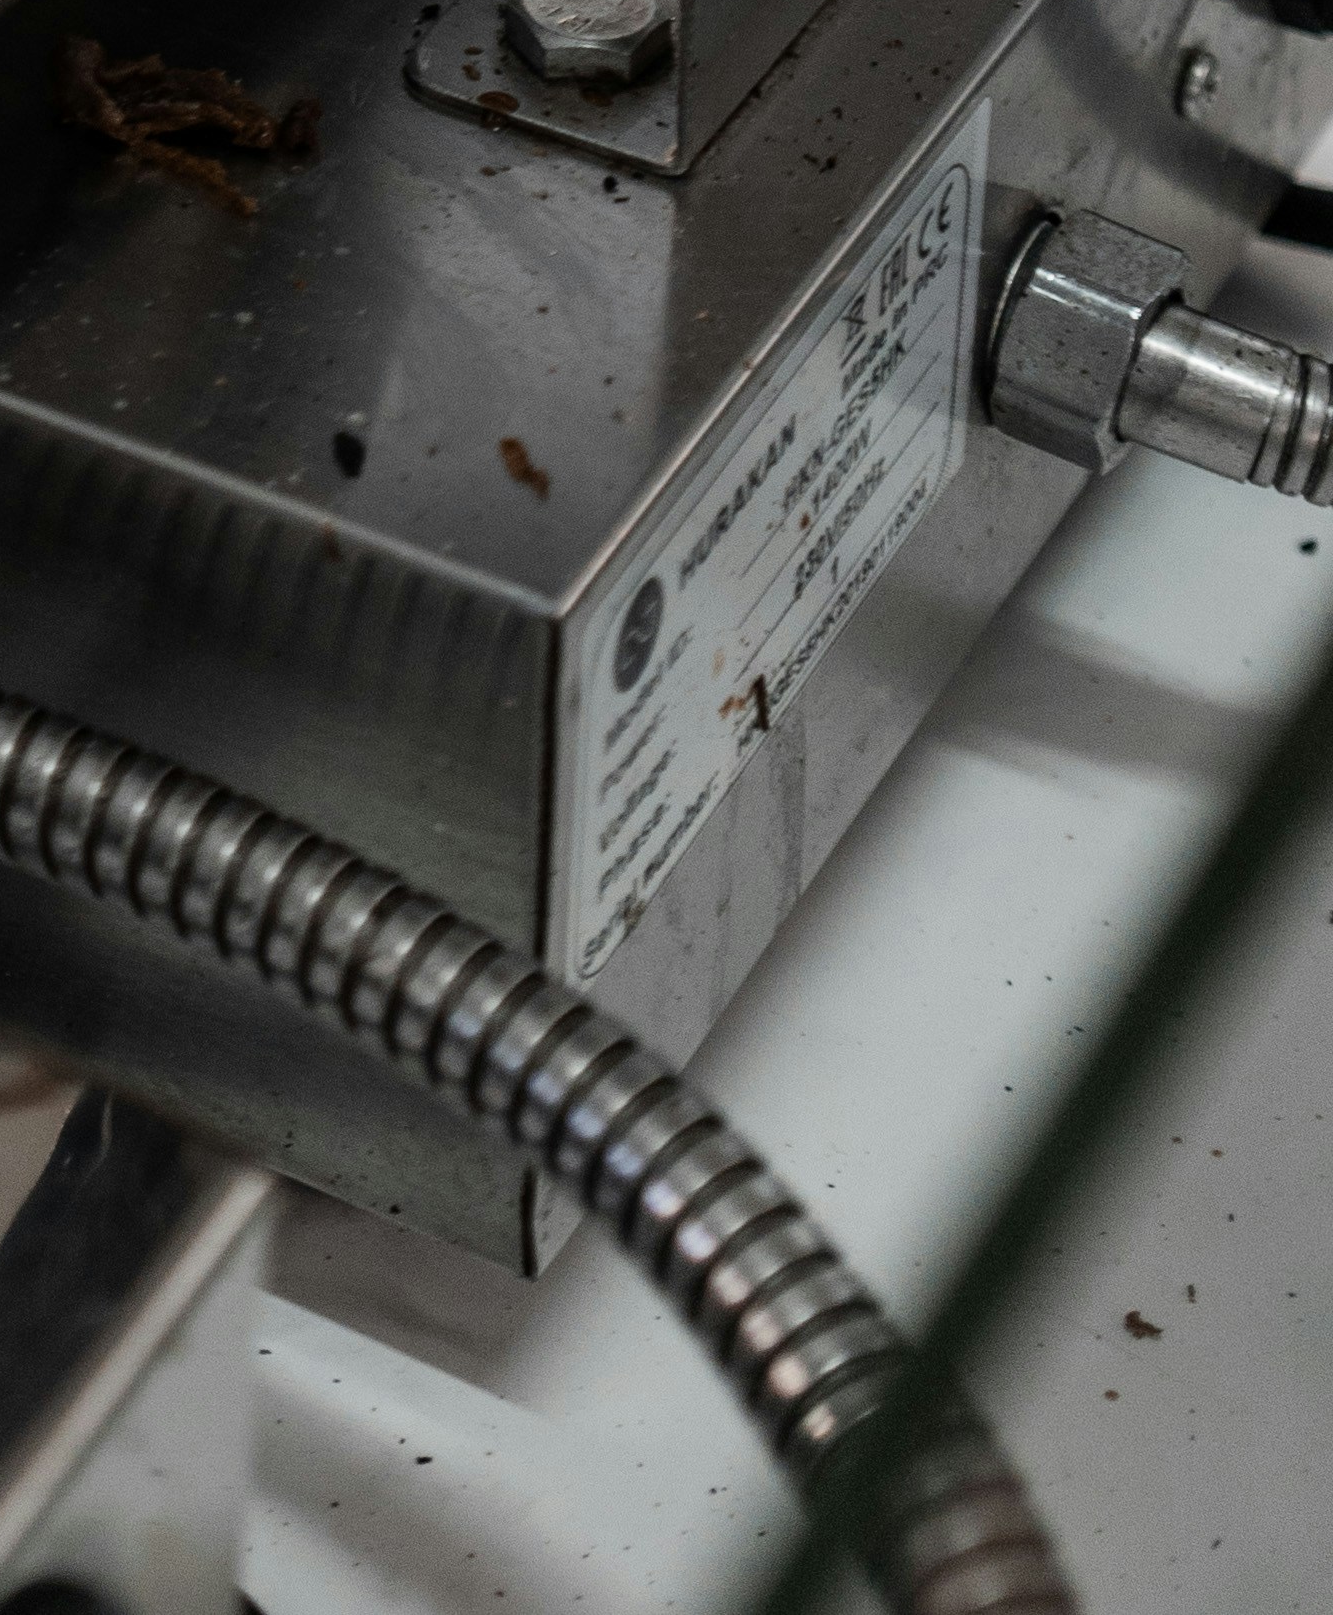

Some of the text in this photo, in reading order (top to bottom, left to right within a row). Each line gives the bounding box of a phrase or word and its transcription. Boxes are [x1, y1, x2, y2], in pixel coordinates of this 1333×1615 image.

[841, 327, 888, 401] Made
[912, 241, 950, 307] PRC
[680, 412, 797, 593] HURAKAN
